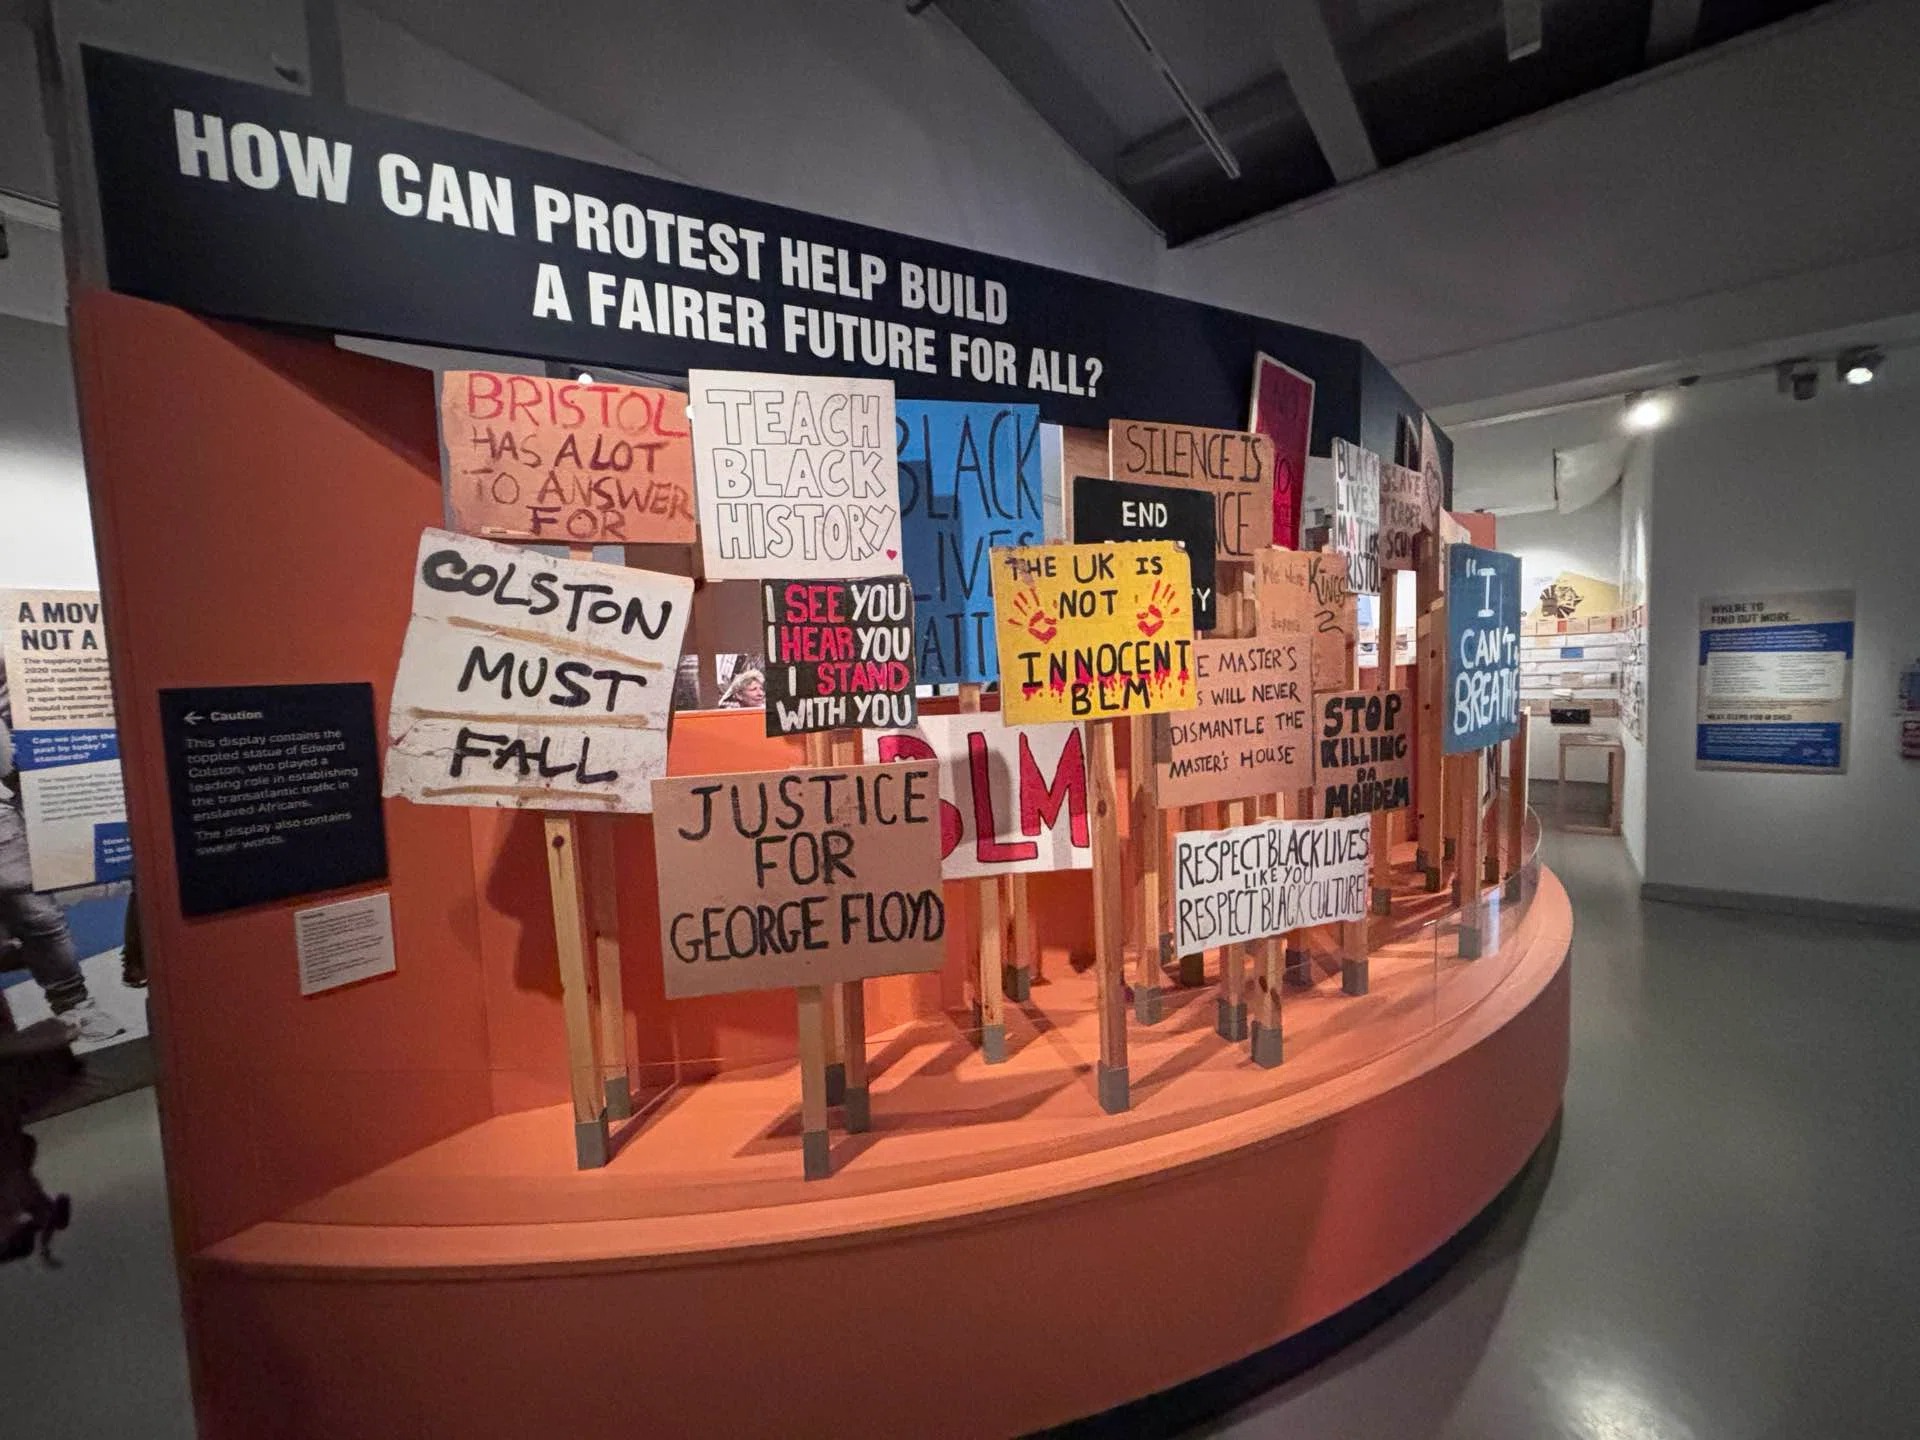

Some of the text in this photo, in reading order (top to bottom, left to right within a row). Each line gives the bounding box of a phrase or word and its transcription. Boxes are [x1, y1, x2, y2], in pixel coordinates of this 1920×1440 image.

[173, 108, 1008, 325] HOW CAN PROTEST HELP BUILD
[532, 263, 1103, 398] A FAIRER FUTURE FOR ALL?
[468, 372, 688, 438] BRISTOL
[706, 390, 881, 449] TEACH
[470, 424, 543, 468] HAS
[896, 410, 1042, 521] BLACK
[1126, 424, 1235, 481] SILENCE
[1240, 436, 1262, 484] IS
[712, 449, 886, 499] BLACK
[462, 468, 695, 520] TO ANSWER
[526, 505, 627, 540] FOR
[1122, 501, 1168, 528] END
[1005, 552, 1163, 584] THE UK IS
[1346, 552, 1381, 592] RISTOL
[18, 602, 99, 624] A MOV
[422, 549, 672, 640] COLSTON
[765, 583, 906, 623] I SEE YOU
[1059, 588, 1118, 620] NOT
[21, 630, 98, 650] NOT A
[767, 626, 911, 664] I HEAR YOU
[1218, 646, 1297, 673] MASTER'S
[457, 646, 648, 711] MUST
[789, 662, 910, 697] I STAND
[1018, 640, 1191, 688] INNOCENT
[776, 693, 911, 732] WITH YOU
[1071, 677, 1151, 716] BLM
[1211, 687, 1246, 706] WILL
[1252, 682, 1301, 703] NEVER
[1453, 667, 1519, 737] BREATHE
[210, 710, 263, 722] Caution
[1170, 710, 1305, 746] DISMANTLE THE
[1323, 693, 1401, 738] STOP
[186, 730, 342, 749] This display contains the
[187, 742, 345, 764] toppled statue of Edward
[450, 727, 618, 784] FALL
[1241, 747, 1296, 769] HOUSE
[1321, 733, 1407, 768] KILLING
[189, 768, 358, 793] leading role in establishing
[248, 760, 275, 772] who
[278, 757, 318, 770] played
[320, 757, 329, 766] a
[192, 780, 349, 806] the transatlantic traffic in
[678, 771, 929, 842] JUSTICE
[193, 806, 254, 822] enslaved
[195, 811, 352, 841] The display also contains
[755, 830, 857, 888] FOR
[1179, 827, 1370, 890] RESPECT BLACK LIVES
[1245, 865, 1313, 889] LIKE YOU
[670, 889, 945, 964] GEORGE FLOYD
[1179, 874, 1366, 946] RESPECT BLACK CULTURE
